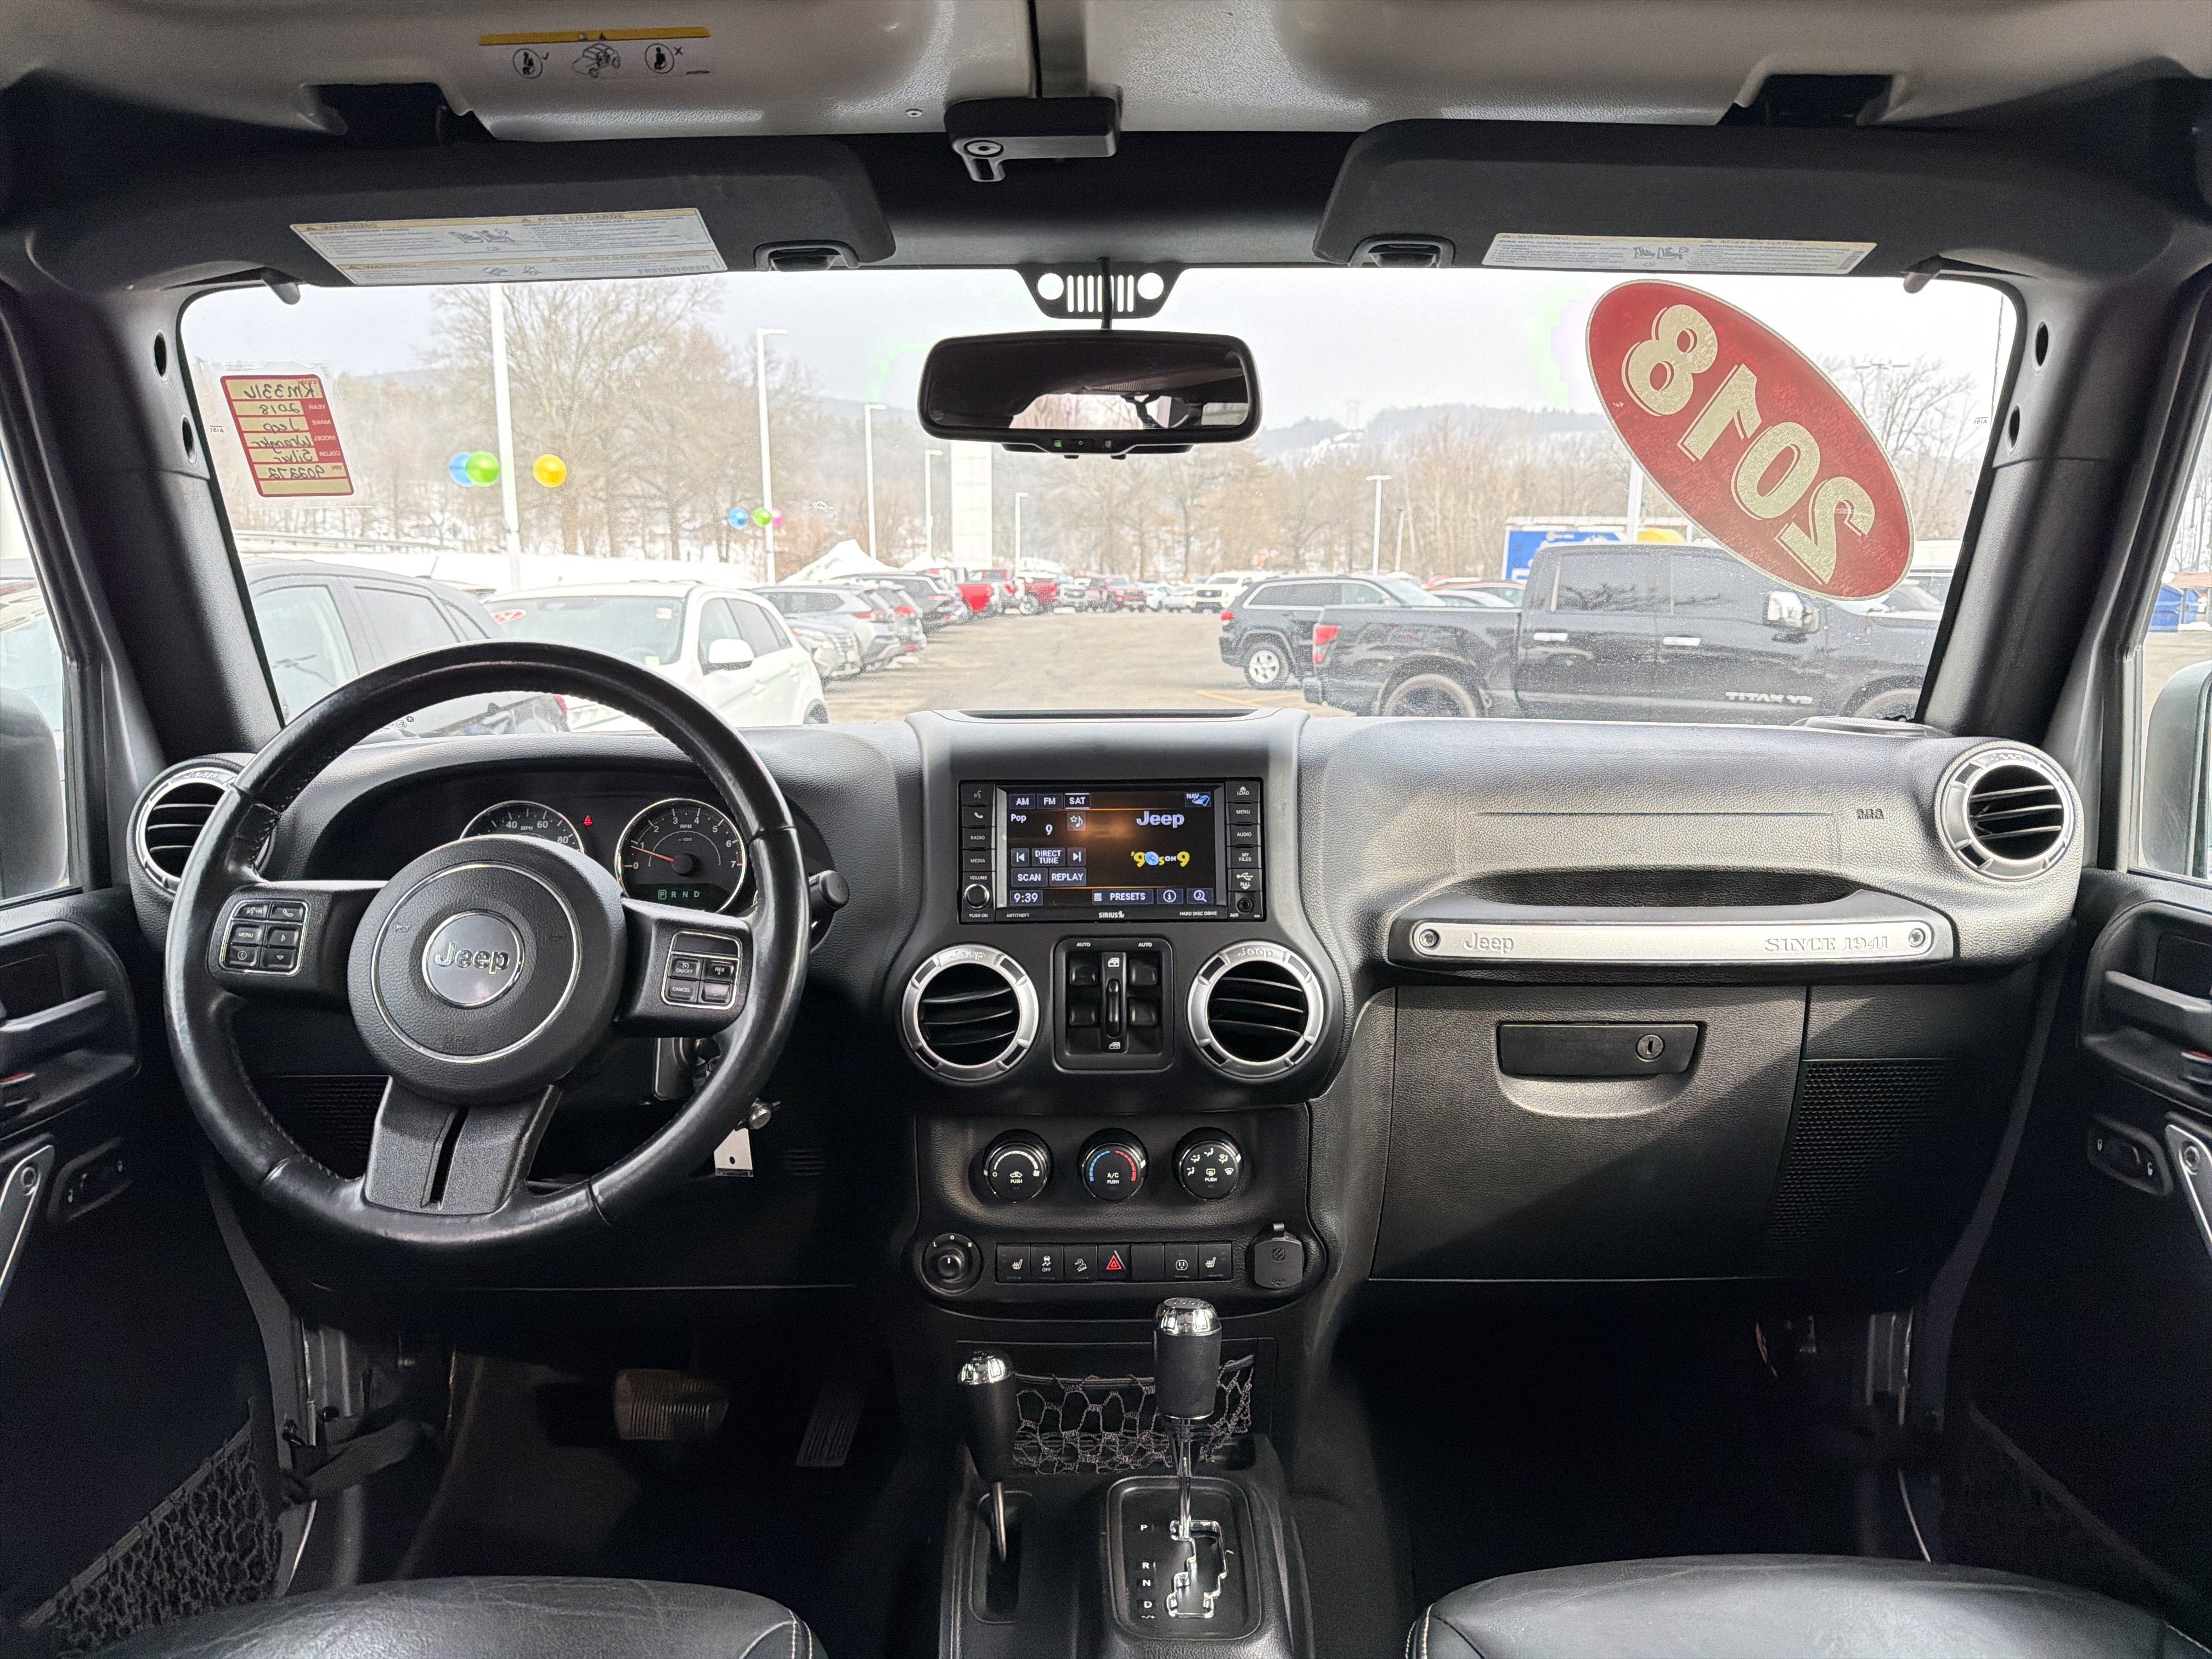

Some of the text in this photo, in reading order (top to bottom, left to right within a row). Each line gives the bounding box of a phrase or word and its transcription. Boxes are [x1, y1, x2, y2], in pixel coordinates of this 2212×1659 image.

[1725, 691, 1784, 703] TITAN
[1016, 797, 1029, 805] AM
[1069, 797, 1086, 805] SAT
[1011, 814, 1026, 823] Pop
[1136, 811, 1184, 828] Jeep
[505, 821, 518, 829] 40
[1045, 824, 1053, 836] 9
[557, 836, 569, 844] 80
[1017, 873, 1041, 882] SCAN
[1051, 873, 1084, 882] REPLAY
[1014, 893, 1038, 903] 9:39
[1109, 893, 1146, 901] PRESETS
[1463, 932, 1514, 955] Jeep
[1764, 936, 1889, 952] SINCE 1941
[950, 950, 985, 961] Jeep
[1238, 947, 1273, 957] Jeep
[435, 941, 510, 974] Jeep
